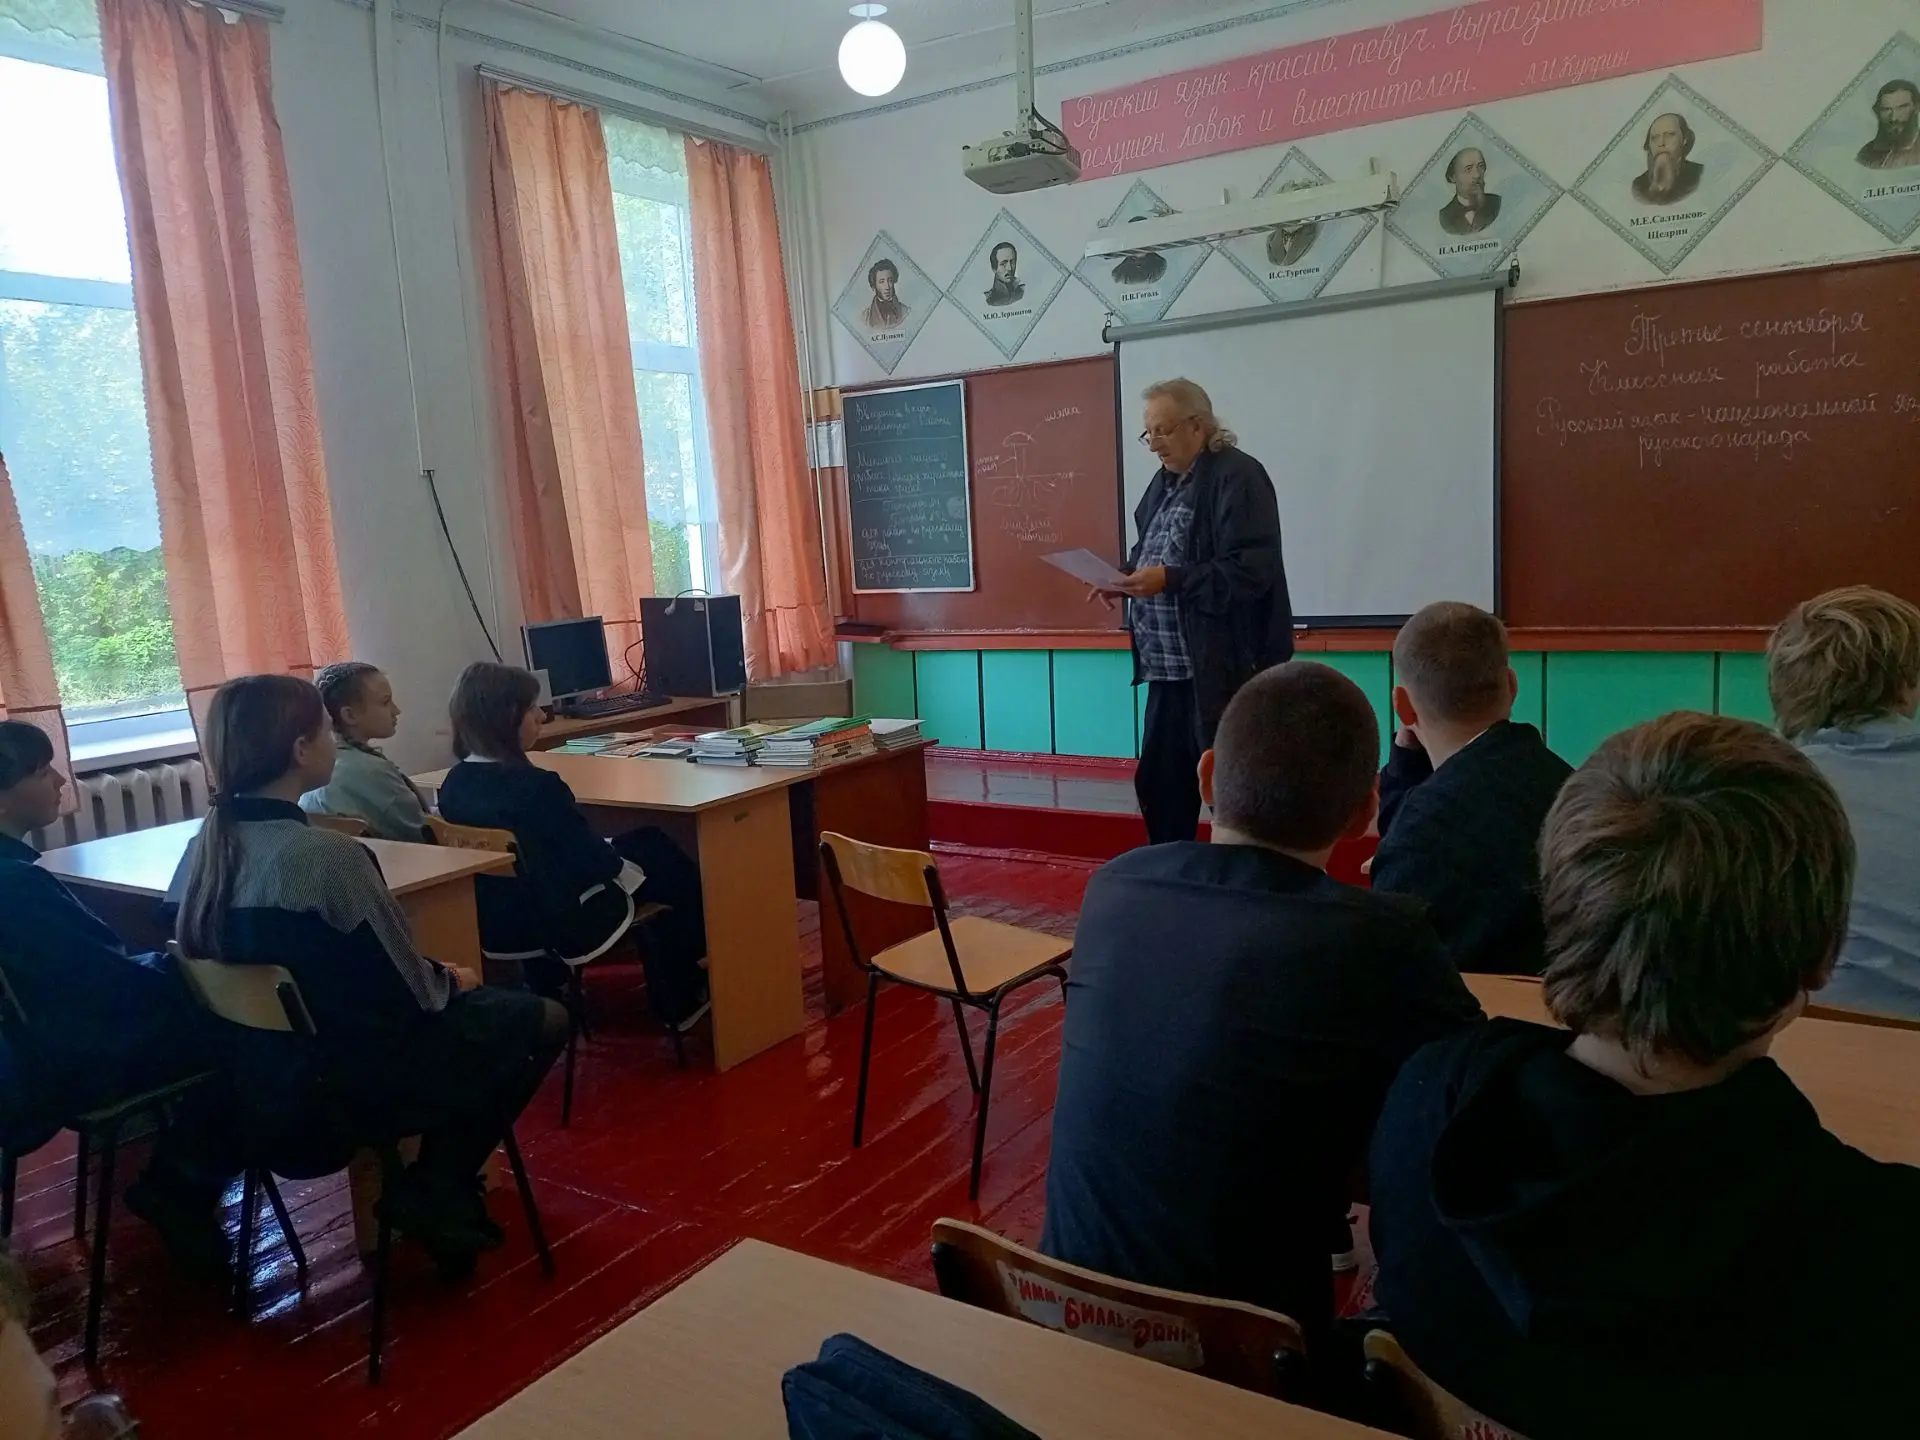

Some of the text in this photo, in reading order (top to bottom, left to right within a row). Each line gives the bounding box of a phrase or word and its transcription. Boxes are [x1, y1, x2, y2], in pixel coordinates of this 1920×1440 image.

[1073, 84, 1159, 141] Русский
[1178, 106, 1246, 148] ловок
[1257, 107, 1277, 132] и
[1292, 68, 1476, 126] вместителен.
[1438, 241, 1499, 256] Н.А.Некрасов
[1624, 307, 1871, 367] Третье сентября
[1580, 349, 1866, 398] Классная работа
[1536, 396, 1625, 446] Русский
[1630, 408, 1681, 434] язык
[1700, 394, 1877, 426] национальный
[1638, 428, 1812, 469] русского народа
